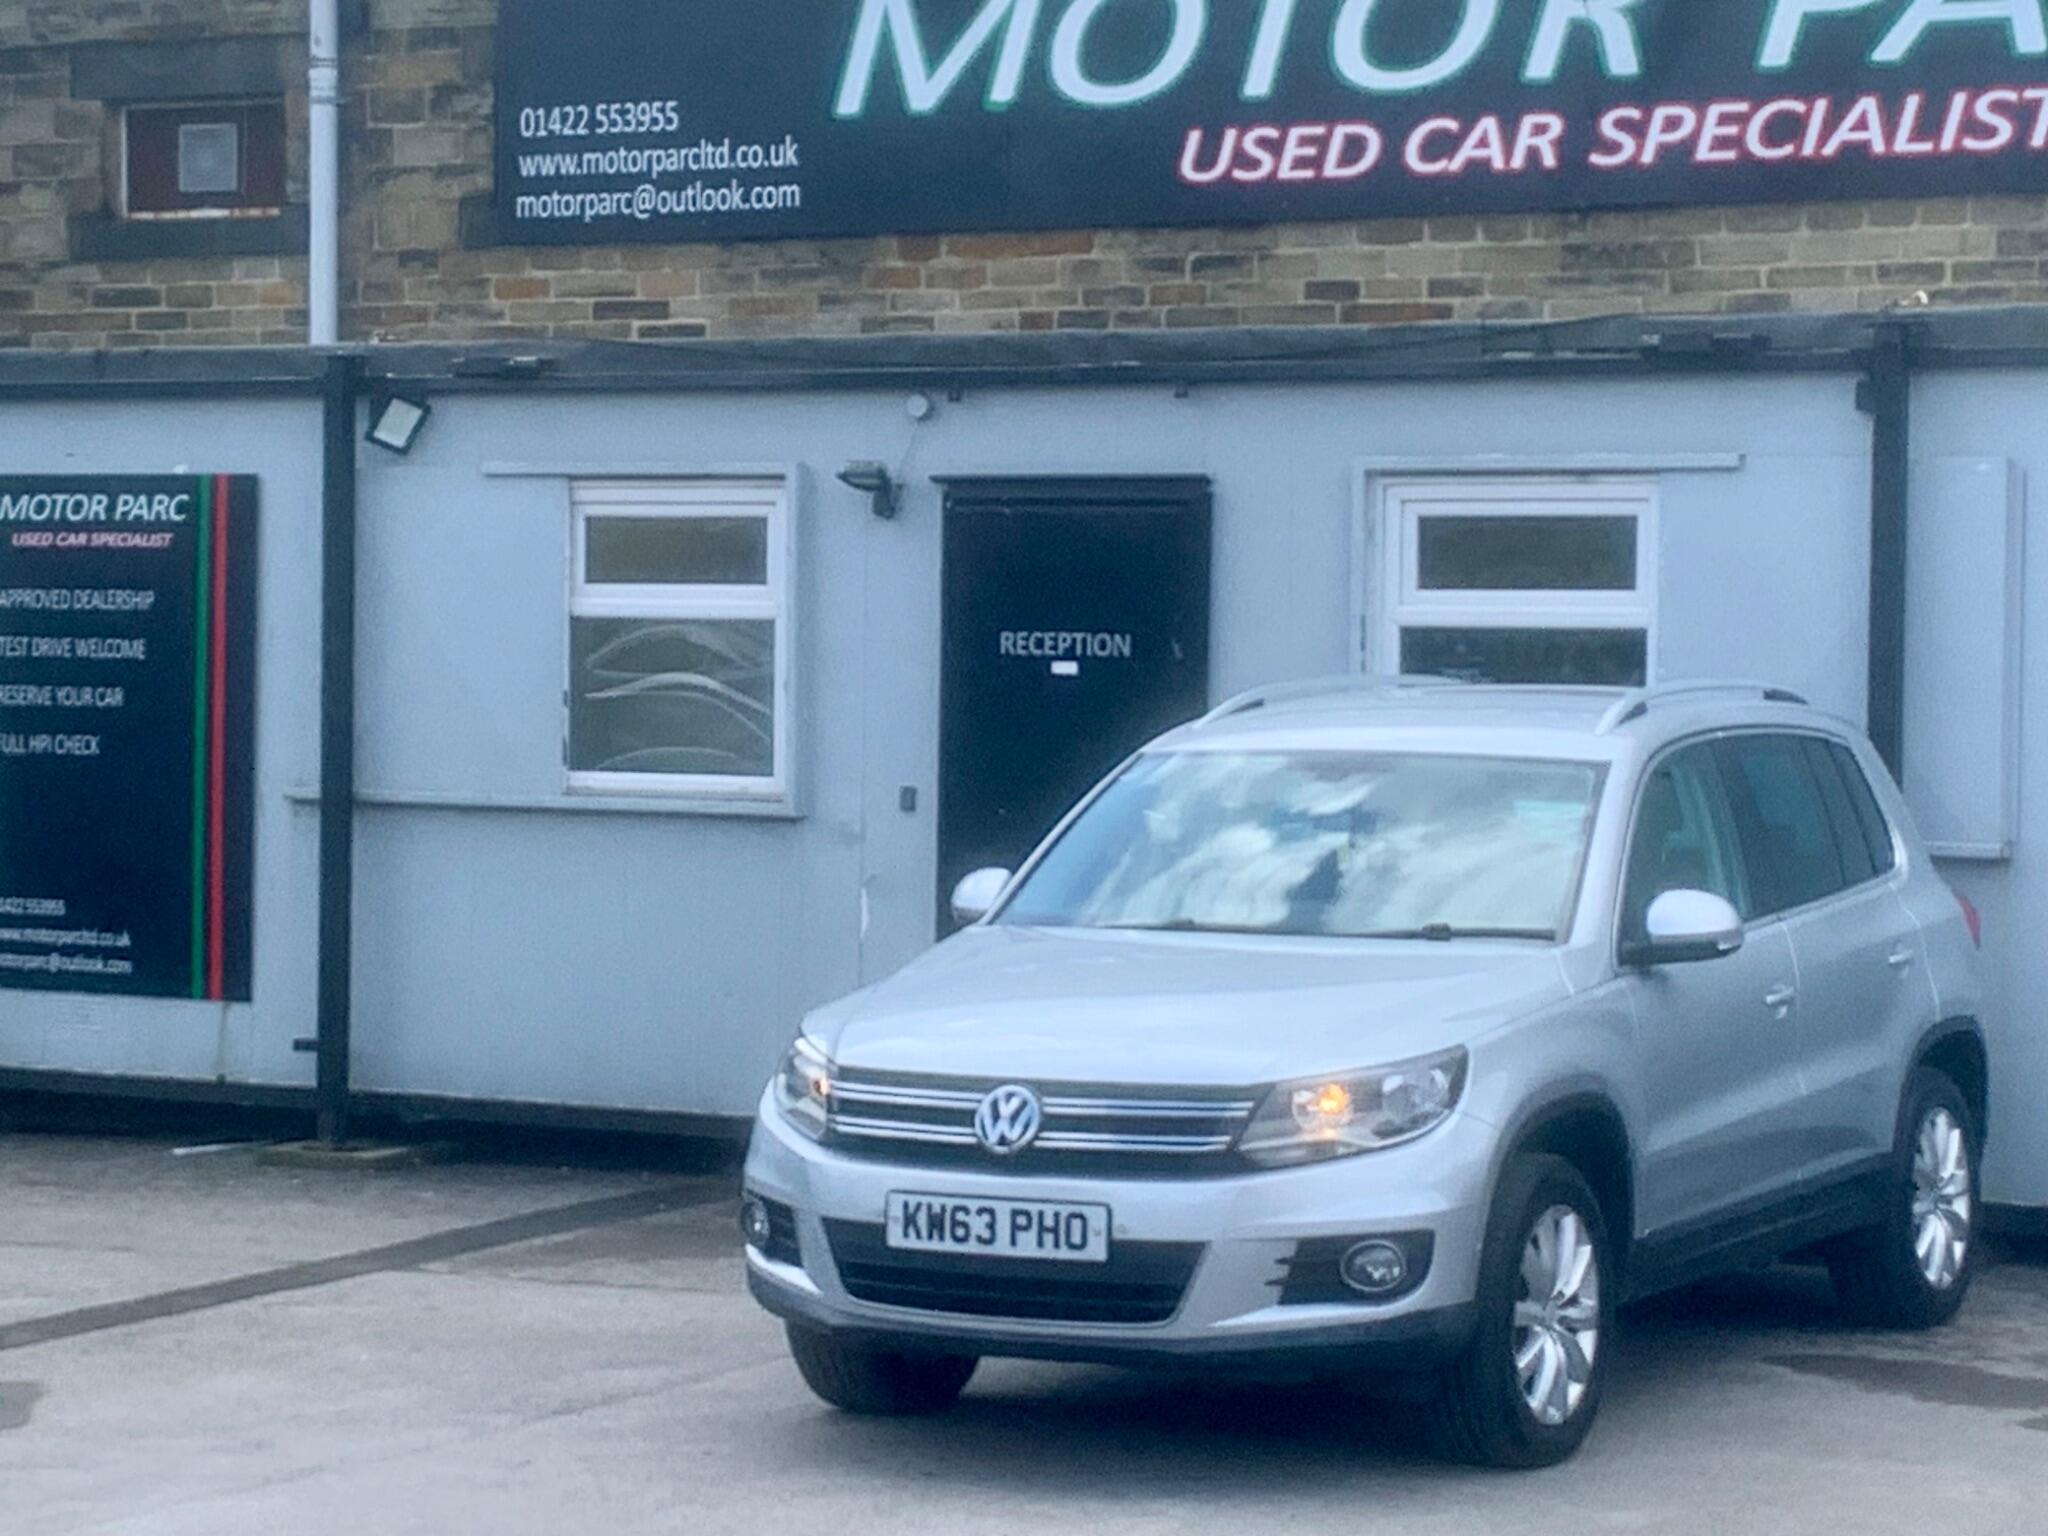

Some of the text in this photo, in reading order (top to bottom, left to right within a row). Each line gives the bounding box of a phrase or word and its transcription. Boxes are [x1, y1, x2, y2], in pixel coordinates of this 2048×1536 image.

[519, 101, 679, 137] 01422 553955
[1179, 87, 2048, 181] USED CAR SPECIALIST
[518, 134, 799, 179] www.motorparcltd.co.uk
[516, 179, 800, 223] motorparc@outlook.com
[0, 494, 190, 521] MOTOR PARC
[12, 532, 174, 548] USED CAR SPECIALIST
[0, 588, 154, 611] APPROVED DEALERSHIP
[0, 636, 146, 660] TEST DRIVE WELCOME
[1000, 631, 1132, 657] RECEPTION
[55, 685, 94, 706] YOUR
[95, 686, 124, 707] CAR
[0, 732, 26, 754] ULL
[55, 734, 100, 755] CHECK
[902, 1201, 1088, 1250] KW63 PHO
